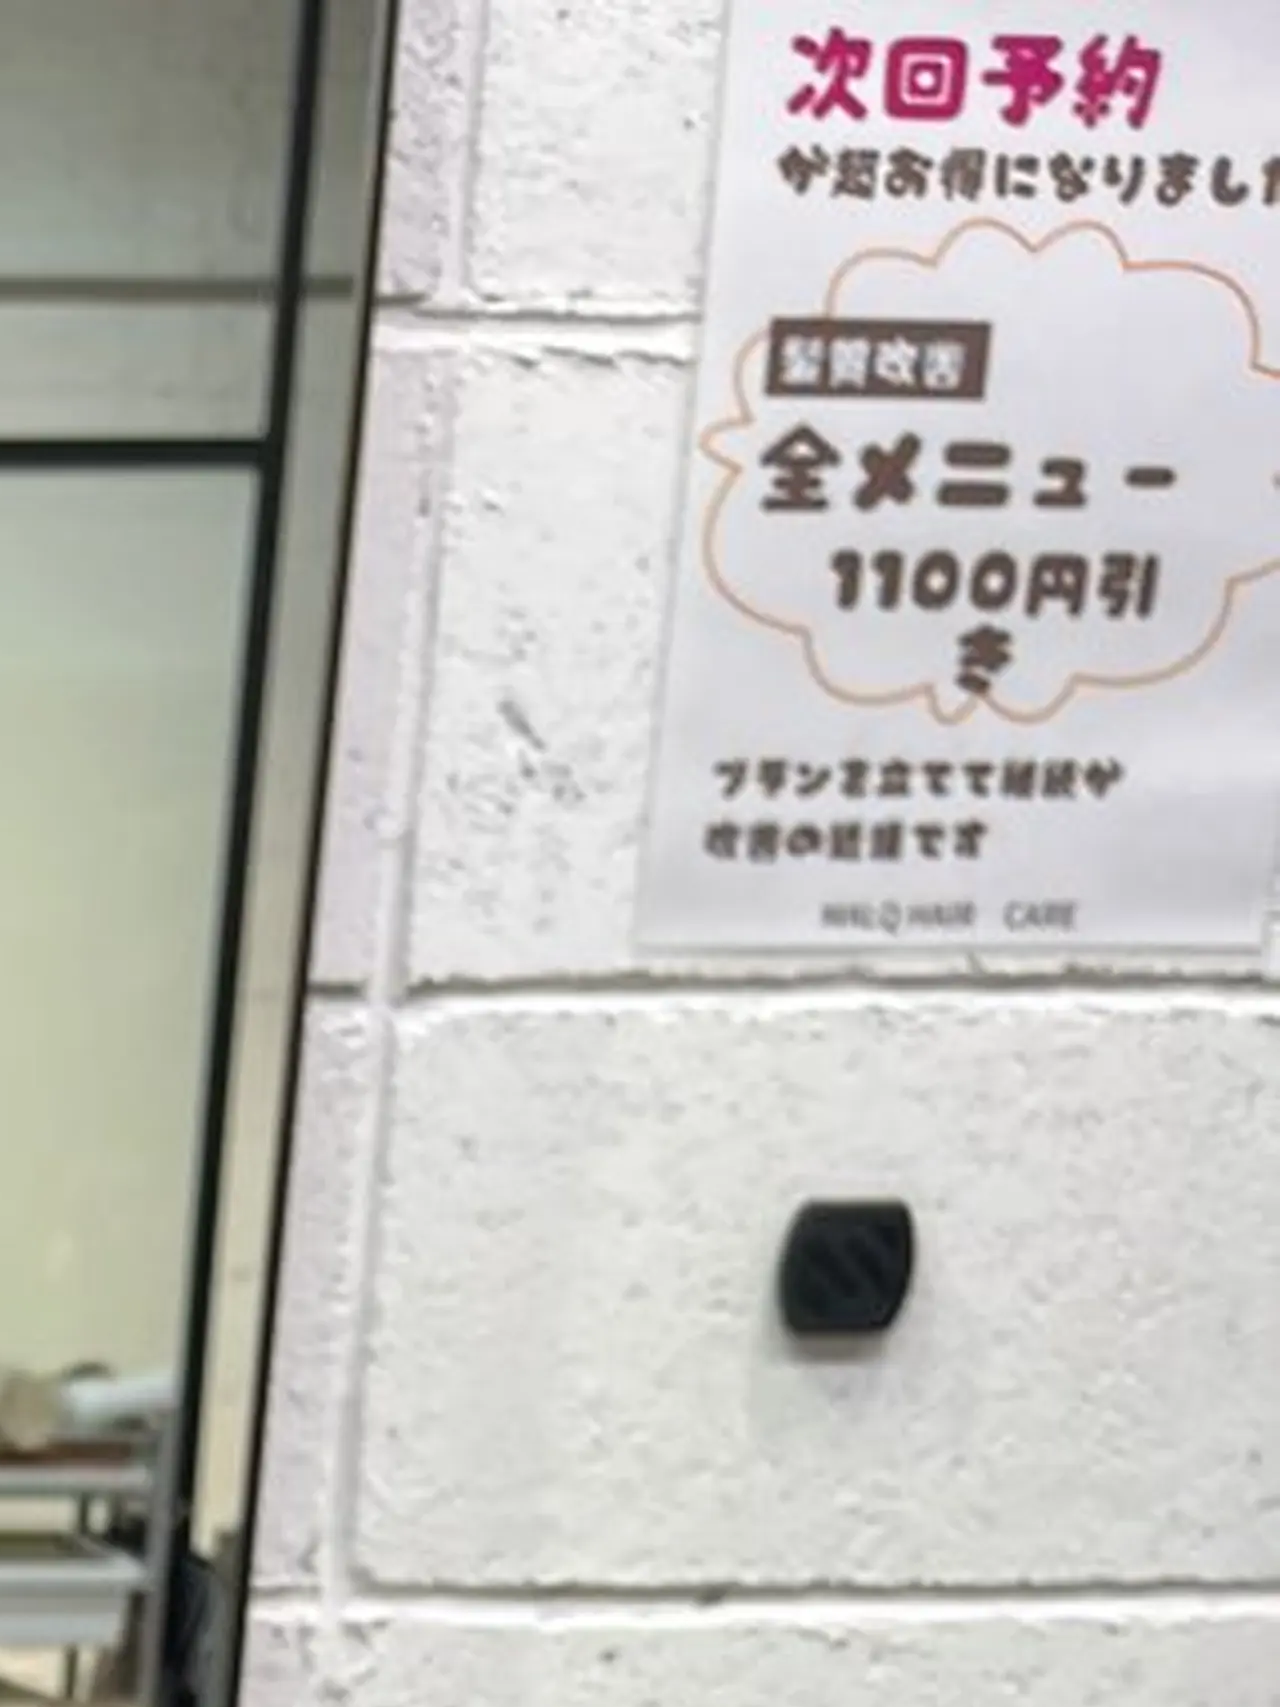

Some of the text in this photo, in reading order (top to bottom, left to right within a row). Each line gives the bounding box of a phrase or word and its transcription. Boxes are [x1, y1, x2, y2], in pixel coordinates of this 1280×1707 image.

[787, 27, 1162, 130] 次回予約
[760, 424, 1177, 512] 全メニュー
[831, 550, 1160, 619] 1100円引
